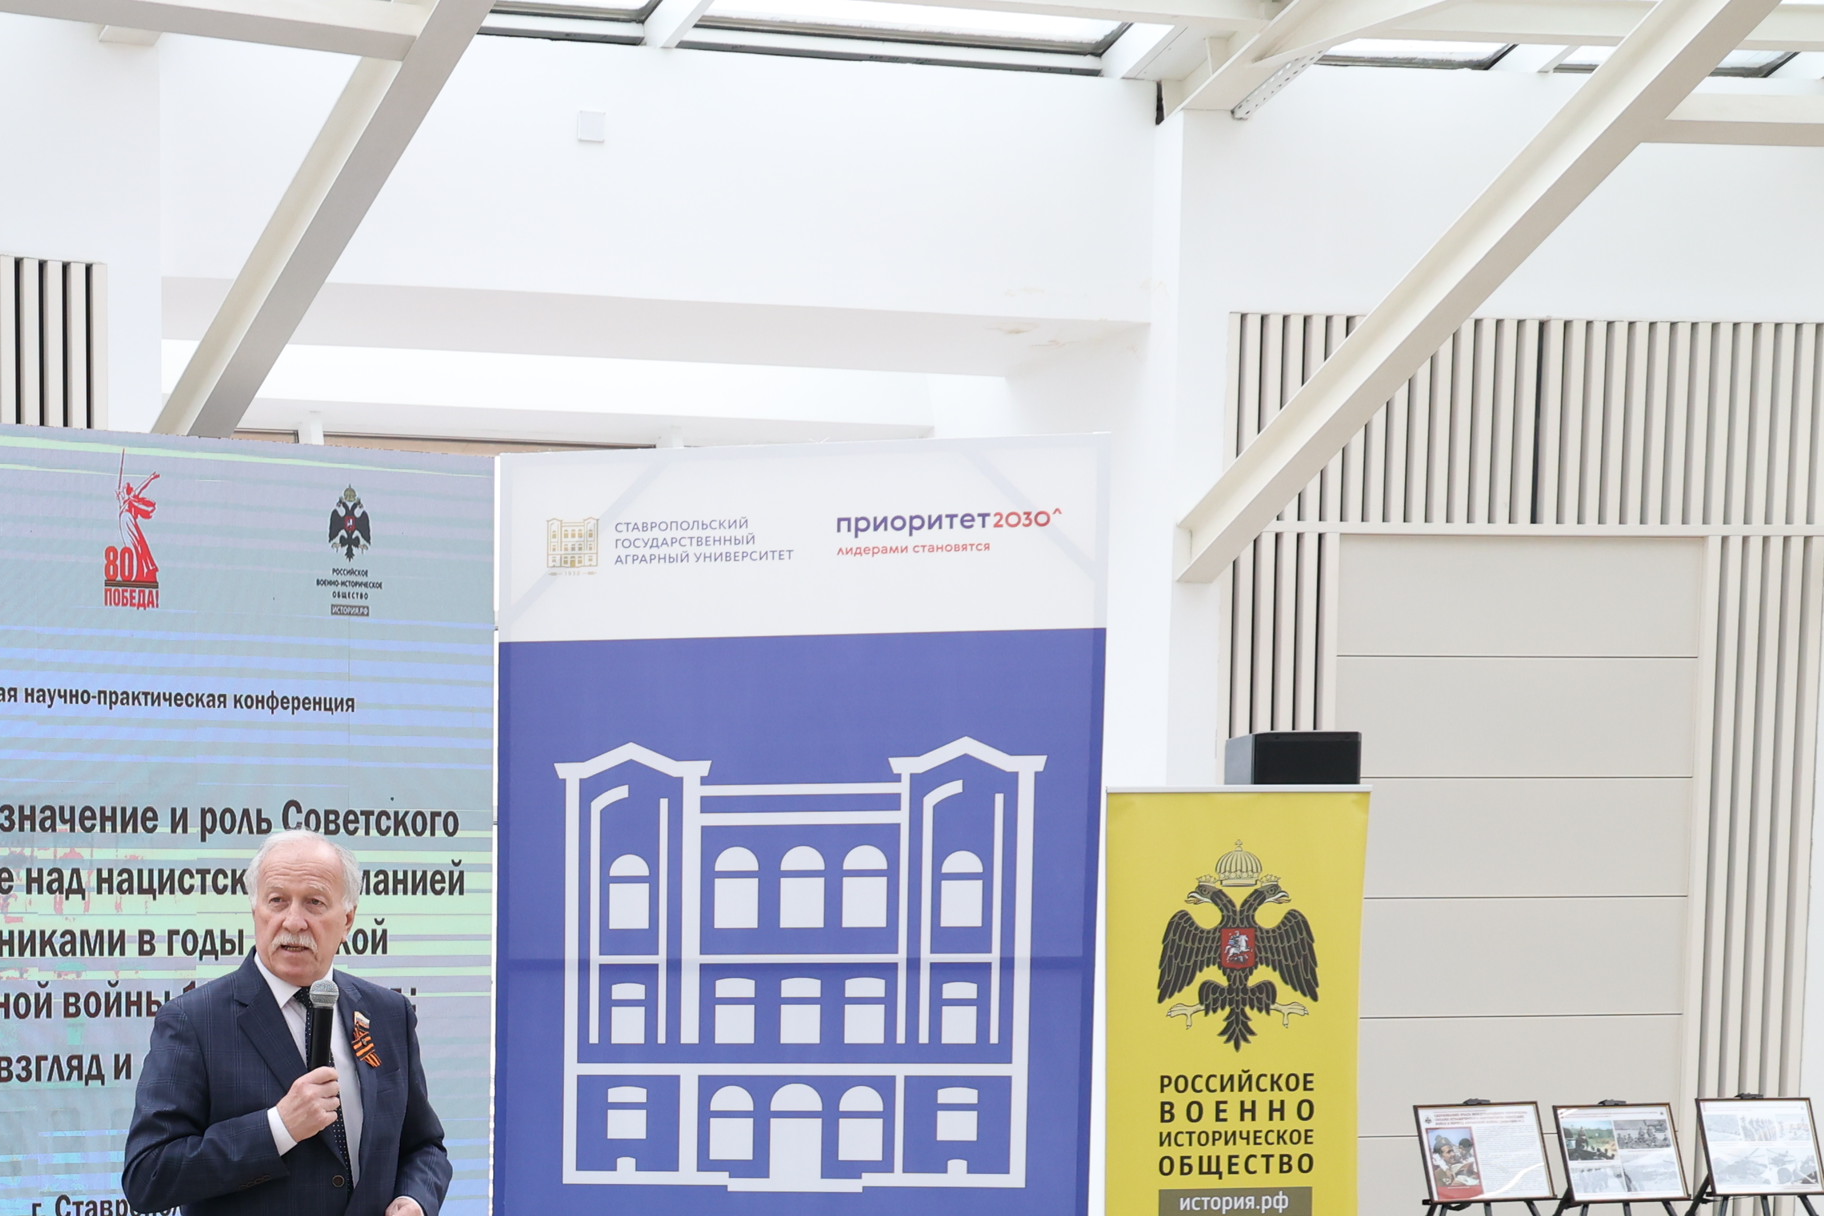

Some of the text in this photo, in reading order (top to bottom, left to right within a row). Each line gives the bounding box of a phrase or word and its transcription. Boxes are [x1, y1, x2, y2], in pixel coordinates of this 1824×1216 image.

[614, 516, 748, 533] СТАВРОПОЛЬСКИЙ
[615, 532, 756, 549] ГОСУДАРСТВЕННЫЙ
[837, 543, 990, 557] лидерами становятся
[104, 546, 134, 581] 80
[614, 549, 794, 566] АГРАРНЫЙ УНИВЕРСИТЕТ
[316, 578, 383, 589] ВОЕННО-ИСТОРИЧЕСКОЕ
[332, 568, 368, 577] РОССИЙСКОЕ
[104, 587, 159, 611] ПОБЕДА!
[332, 591, 369, 600] ОБЩЕСТВО
[332, 606, 368, 615] ИСТОРИЯ.РФ
[24, 685, 227, 710] научно-практическая
[233, 690, 355, 715] конференция
[170, 806, 189, 834] и
[200, 806, 273, 842] роль
[282, 799, 459, 837] Советского
[25, 867, 86, 900] над
[96, 867, 248, 900] нацистск
[138, 929, 156, 957] в
[167, 928, 244, 961] годы
[63, 980, 170, 1020] войны
[114, 1053, 132, 1080] и
[1159, 1069, 1315, 1094] РОССИЙСКОЕ
[1160, 1098, 1315, 1124] ВОЕННО
[1159, 1128, 1314, 1147] ИСТОРИЧЕСКОЕ
[1158, 1152, 1314, 1180] ОБЩЕСТВО
[1179, 1190, 1289, 1215] история.рф
